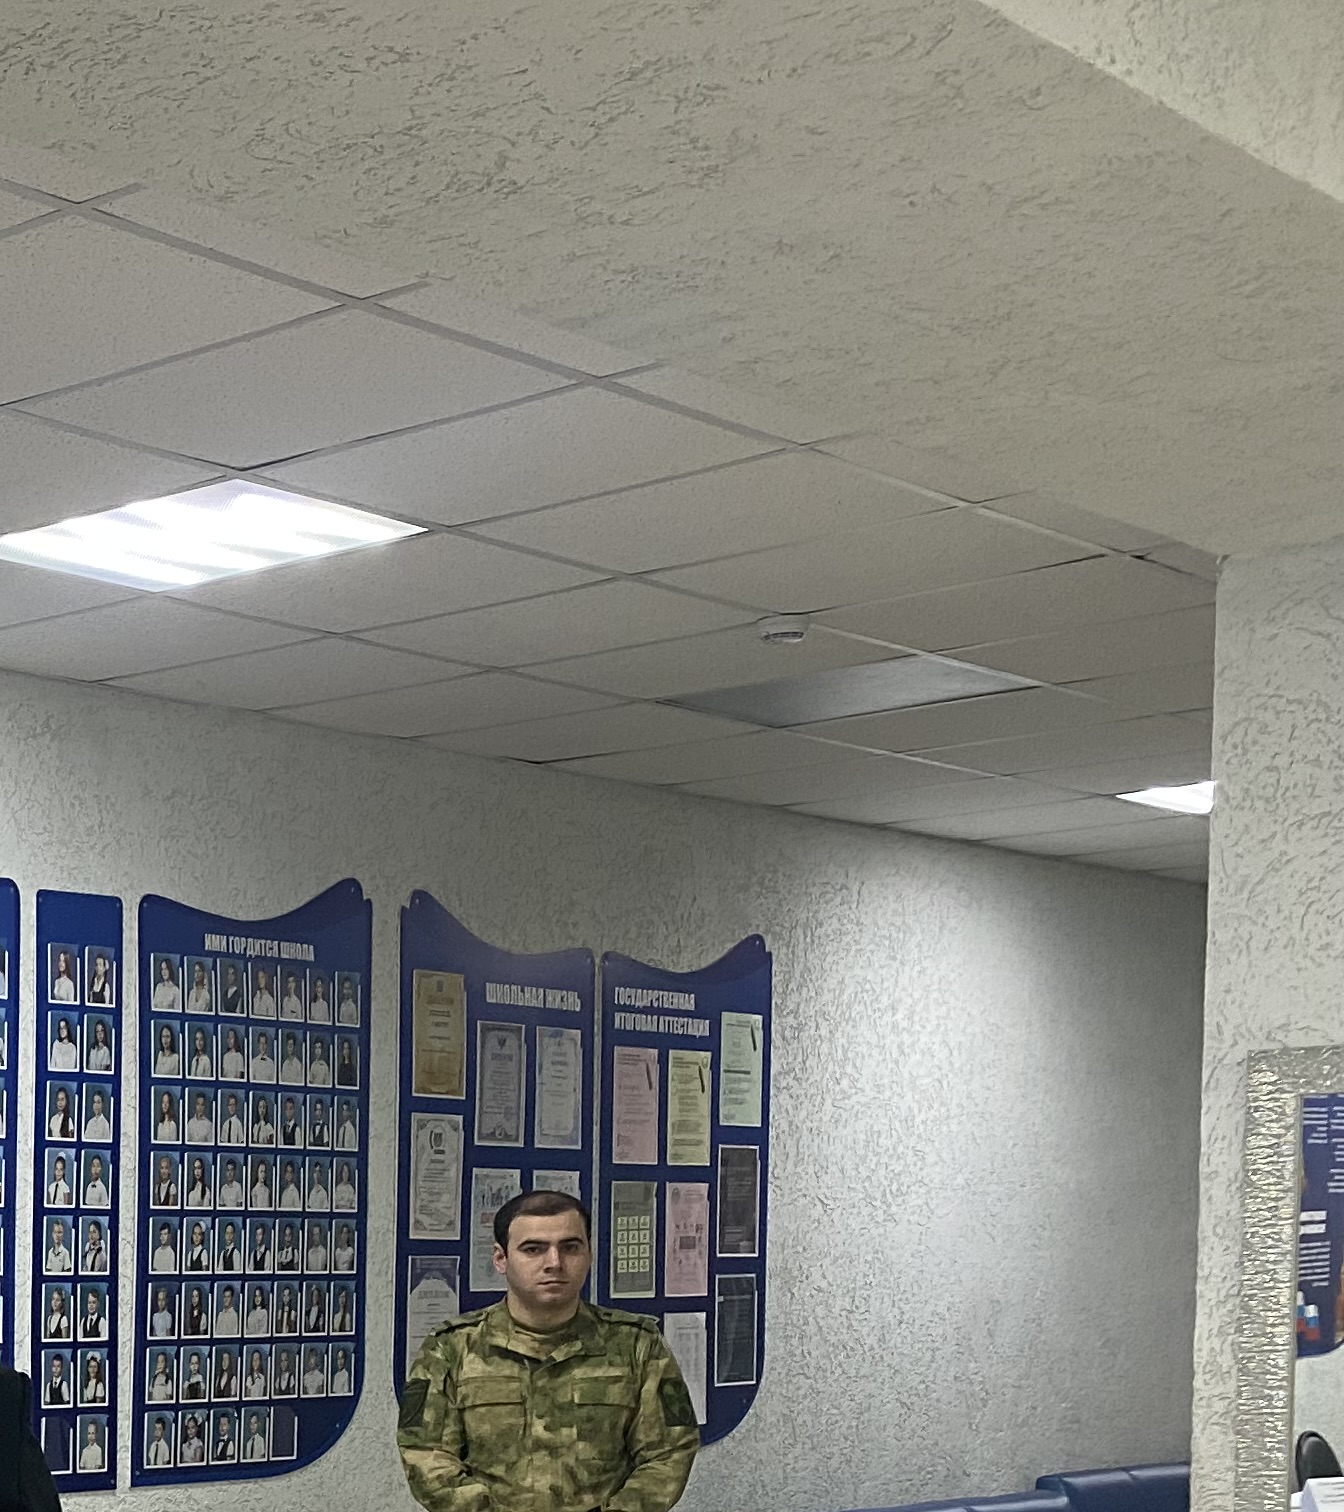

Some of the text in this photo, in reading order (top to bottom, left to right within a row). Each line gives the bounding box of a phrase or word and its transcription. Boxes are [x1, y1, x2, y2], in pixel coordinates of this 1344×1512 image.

[204, 933, 315, 962] ИМИ ГОРДИТСЯ ШКОЛА
[485, 982, 581, 1012] ШКОЛЬНАЯ ЖИЗНЬ
[614, 986, 695, 1011] ГОСУДАРСТВЕННАЯ
